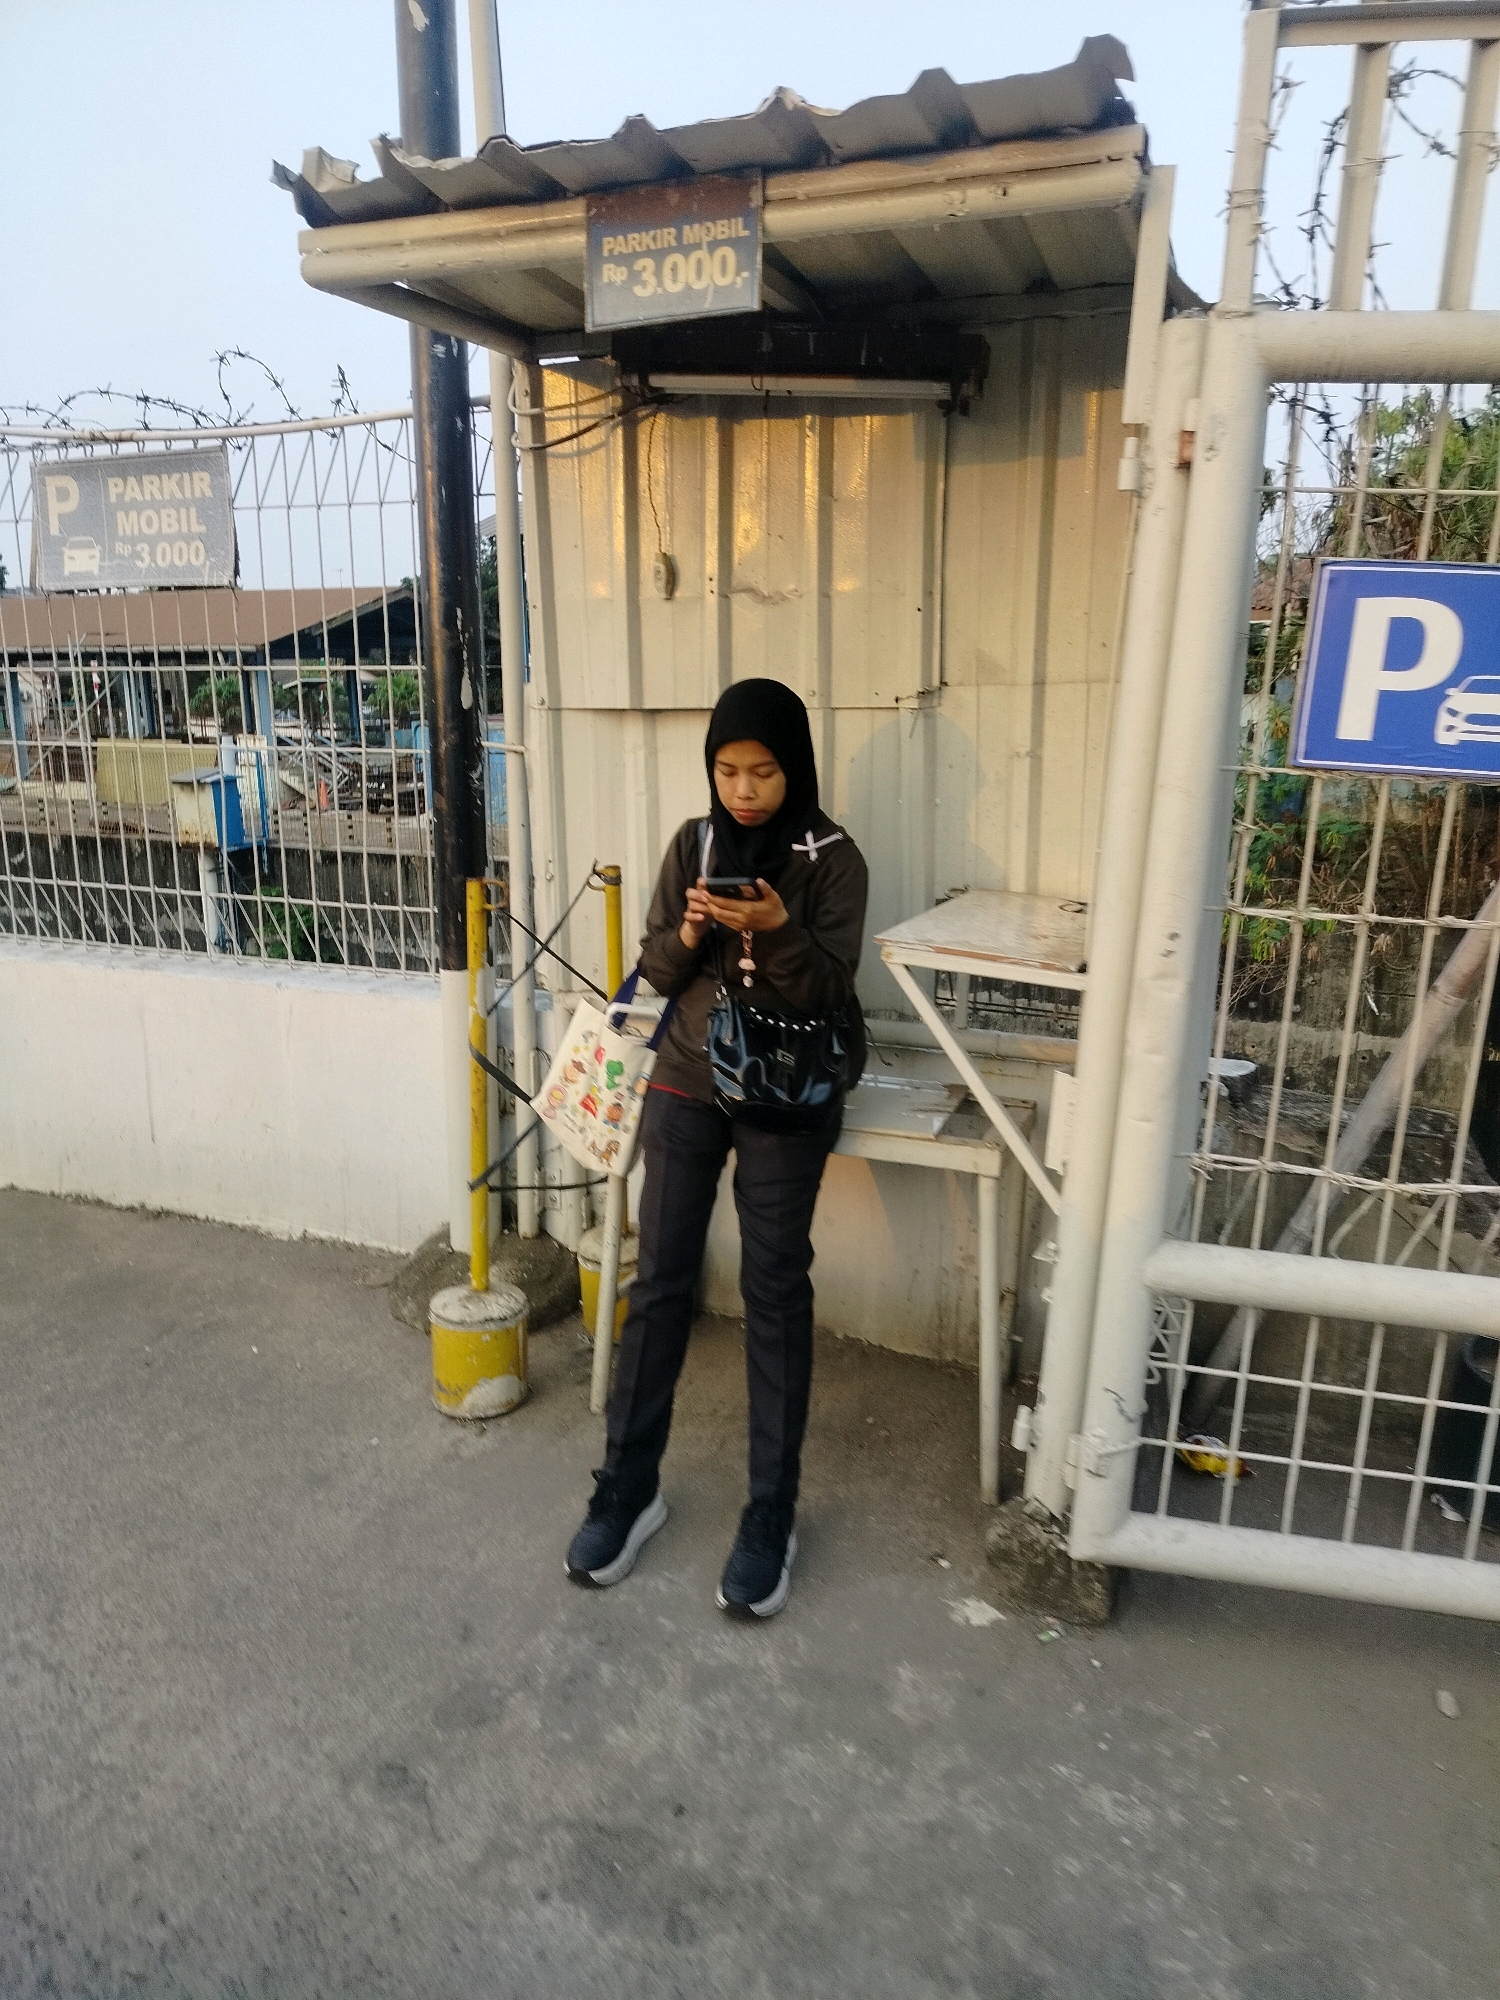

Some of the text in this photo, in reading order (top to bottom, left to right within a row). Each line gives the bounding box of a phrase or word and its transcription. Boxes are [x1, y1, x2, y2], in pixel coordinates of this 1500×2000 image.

[603, 217, 750, 257] PARKIR MOBIL
[602, 263, 629, 284] Rp
[107, 470, 213, 503] PARKIR
[45, 474, 80, 536] P
[116, 507, 206, 536] MOBIL
[115, 540, 132, 557] Rp
[1335, 596, 1464, 741] P
